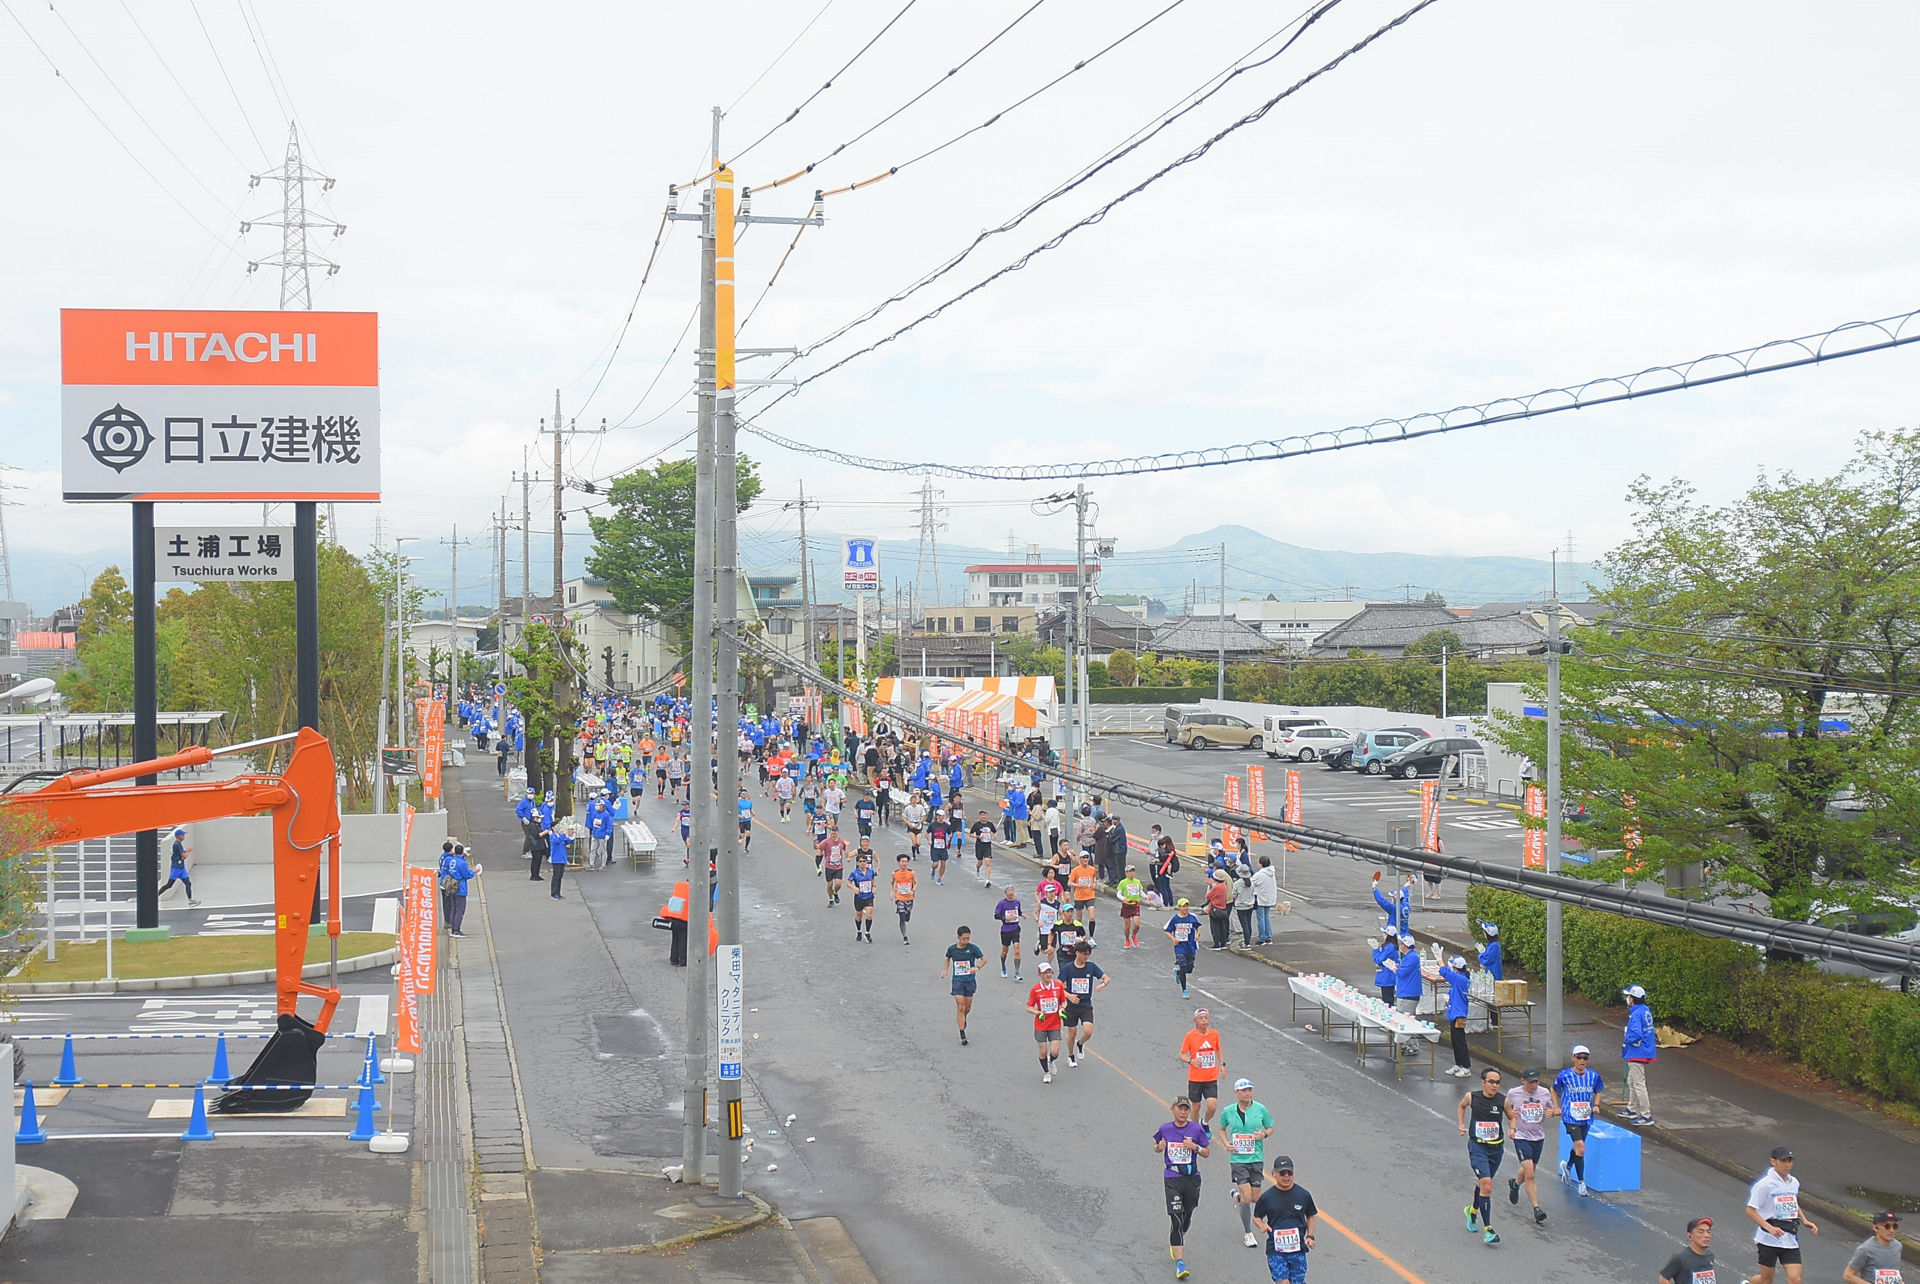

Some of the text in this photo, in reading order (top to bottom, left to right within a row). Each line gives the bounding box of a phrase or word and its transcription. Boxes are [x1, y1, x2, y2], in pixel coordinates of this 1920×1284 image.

[125, 331, 317, 363] HITACHI
[164, 414, 361, 464] 日立建機
[167, 534, 282, 558] 土浦工場
[172, 565, 278, 576] Tsuchiura Works
[731, 947, 742, 1034] 柴田マタニティ
[721, 988, 731, 1037] クリニック
[1527, 1108, 1543, 1116] 1429
[1239, 1139, 1255, 1147] 9338
[1174, 1148, 1191, 1156] 2450
[1282, 1235, 1299, 1244] 1114
